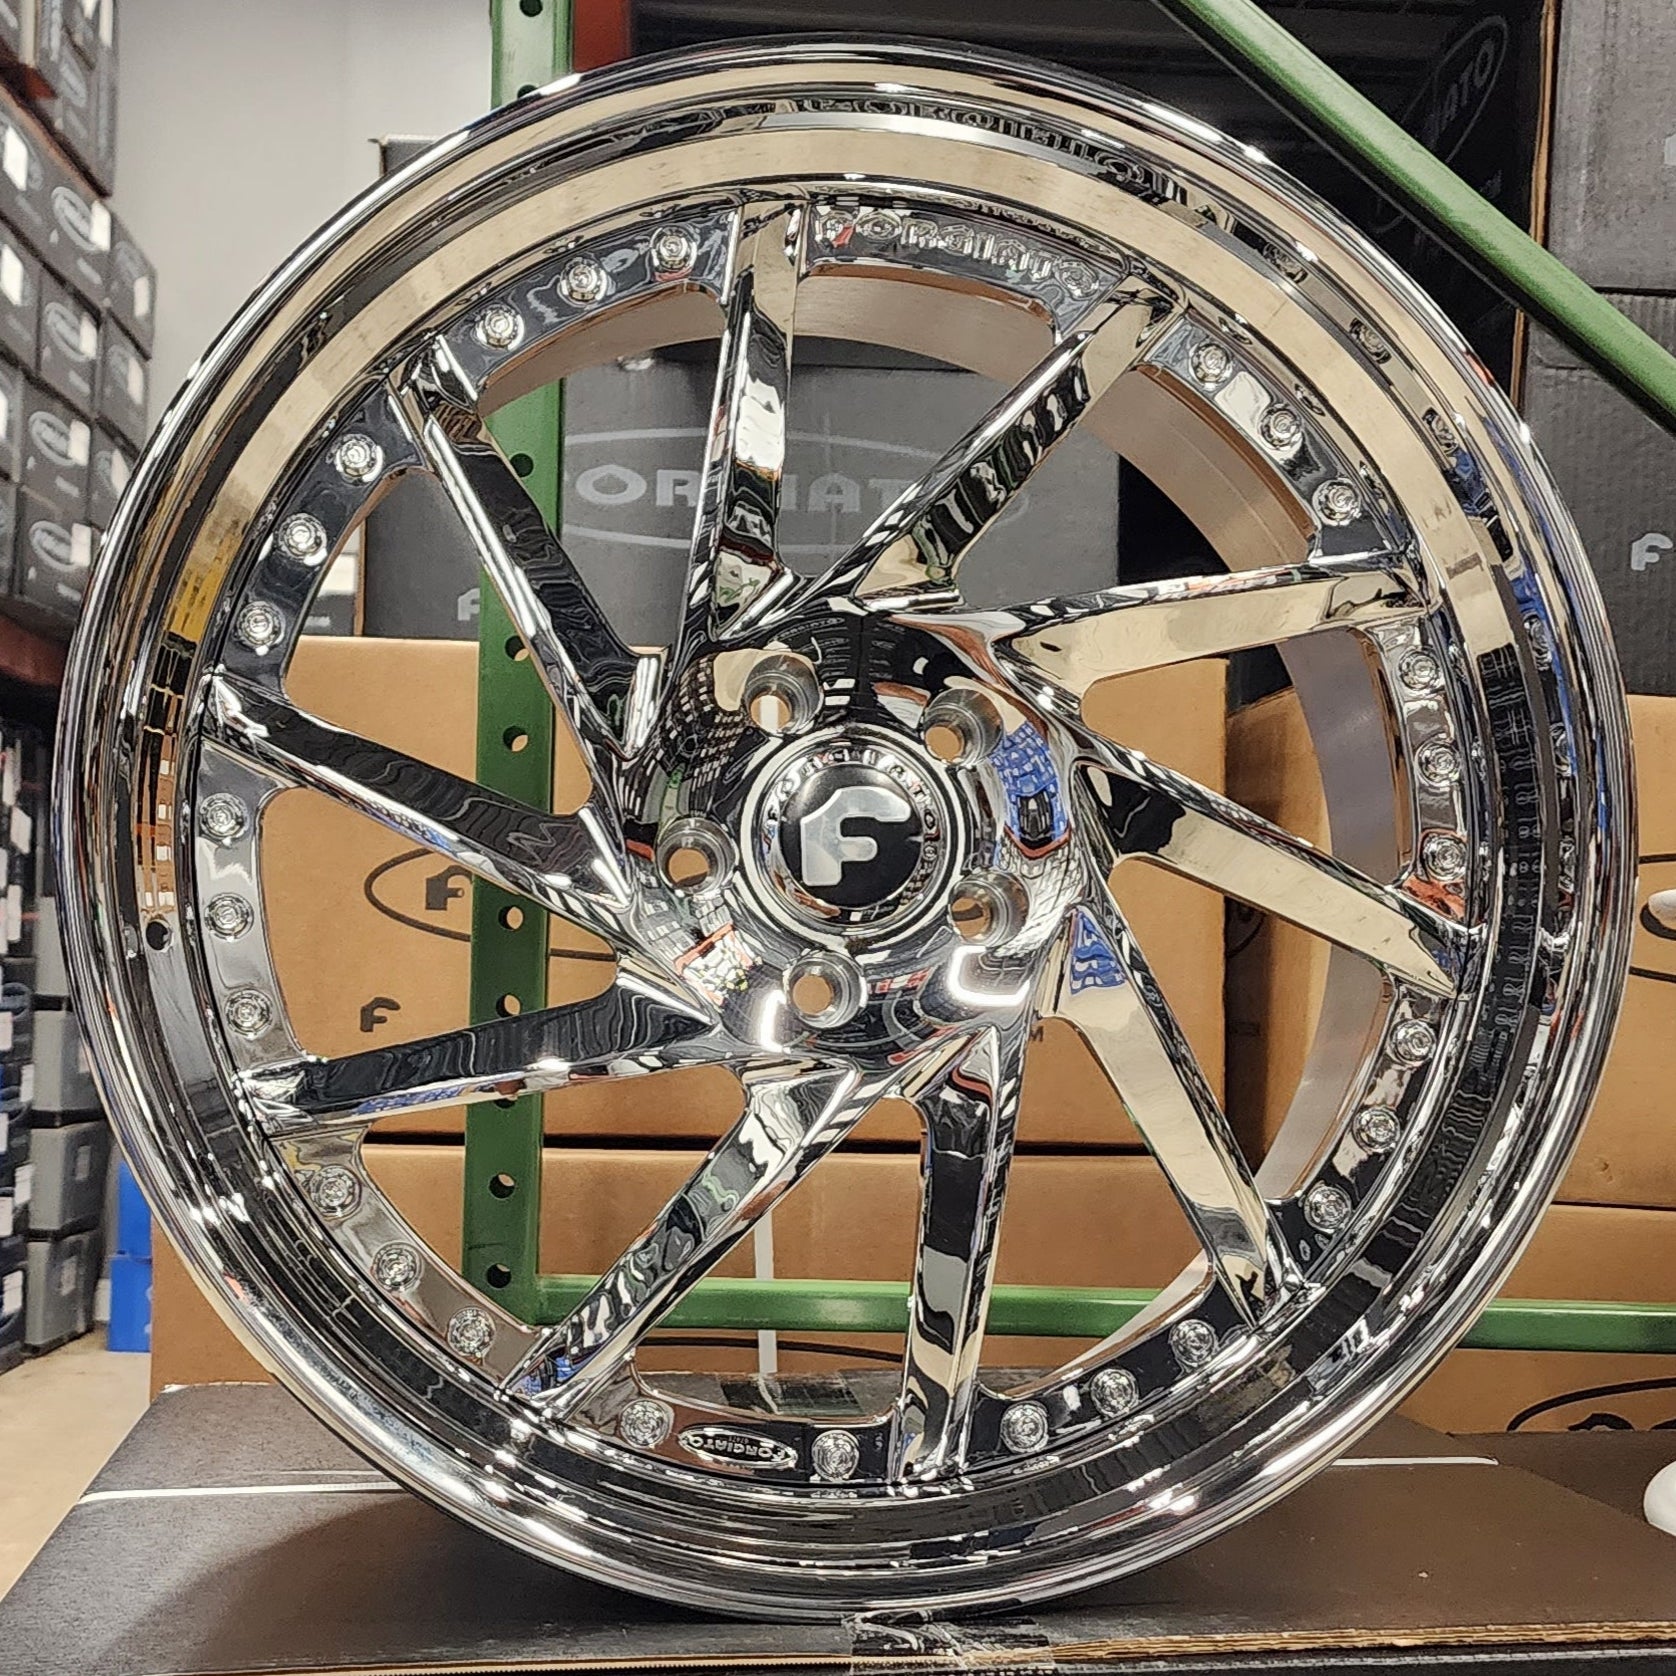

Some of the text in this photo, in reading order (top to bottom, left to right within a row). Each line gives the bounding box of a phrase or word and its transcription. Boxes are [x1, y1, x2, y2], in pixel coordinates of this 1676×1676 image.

[1630, 532, 1674, 571] F
[360, 997, 401, 1033] F
[689, 1434, 787, 1461] FORGIATO
